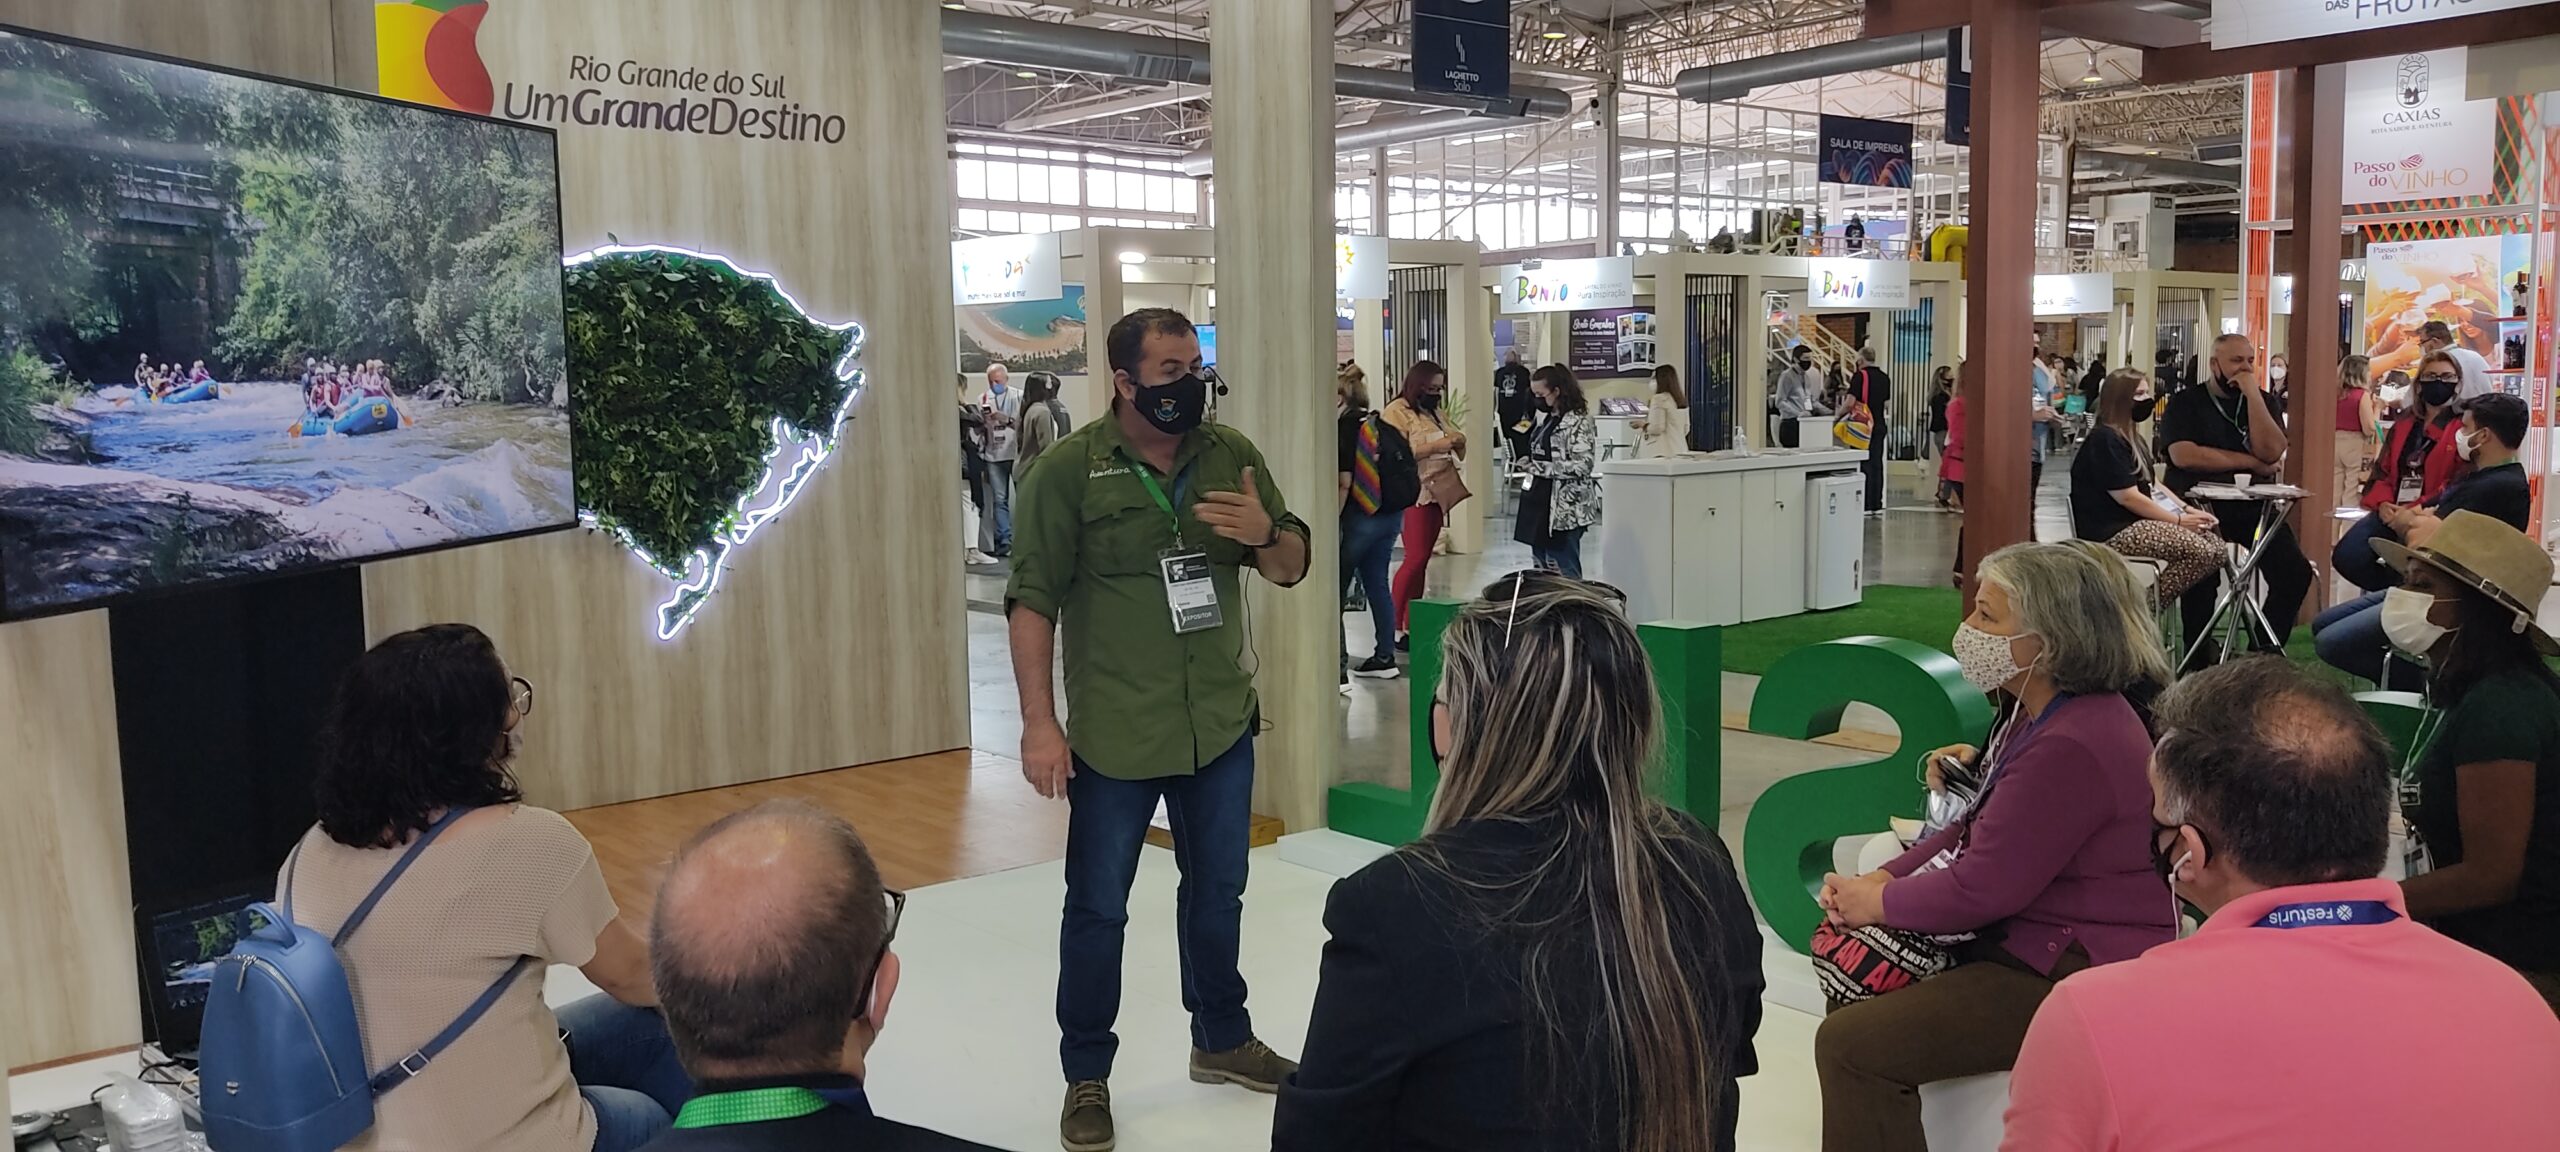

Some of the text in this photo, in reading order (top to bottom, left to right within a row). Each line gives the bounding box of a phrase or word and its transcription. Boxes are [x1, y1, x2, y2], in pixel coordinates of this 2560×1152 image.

[2325, 0, 2349, 11] DAS
[569, 55, 786, 99] Rio Grande do Sul
[1445, 70, 1479, 82] LAGHETTO
[2383, 108, 2441, 125] CAXIAS
[2418, 121, 2453, 130] AVENTURA
[1830, 137, 1904, 154] SALA DE IMPRENSA
[2354, 161, 2395, 174] Passo
[2369, 167, 2469, 190] do VINHO
[2373, 246, 2398, 254] Passo
